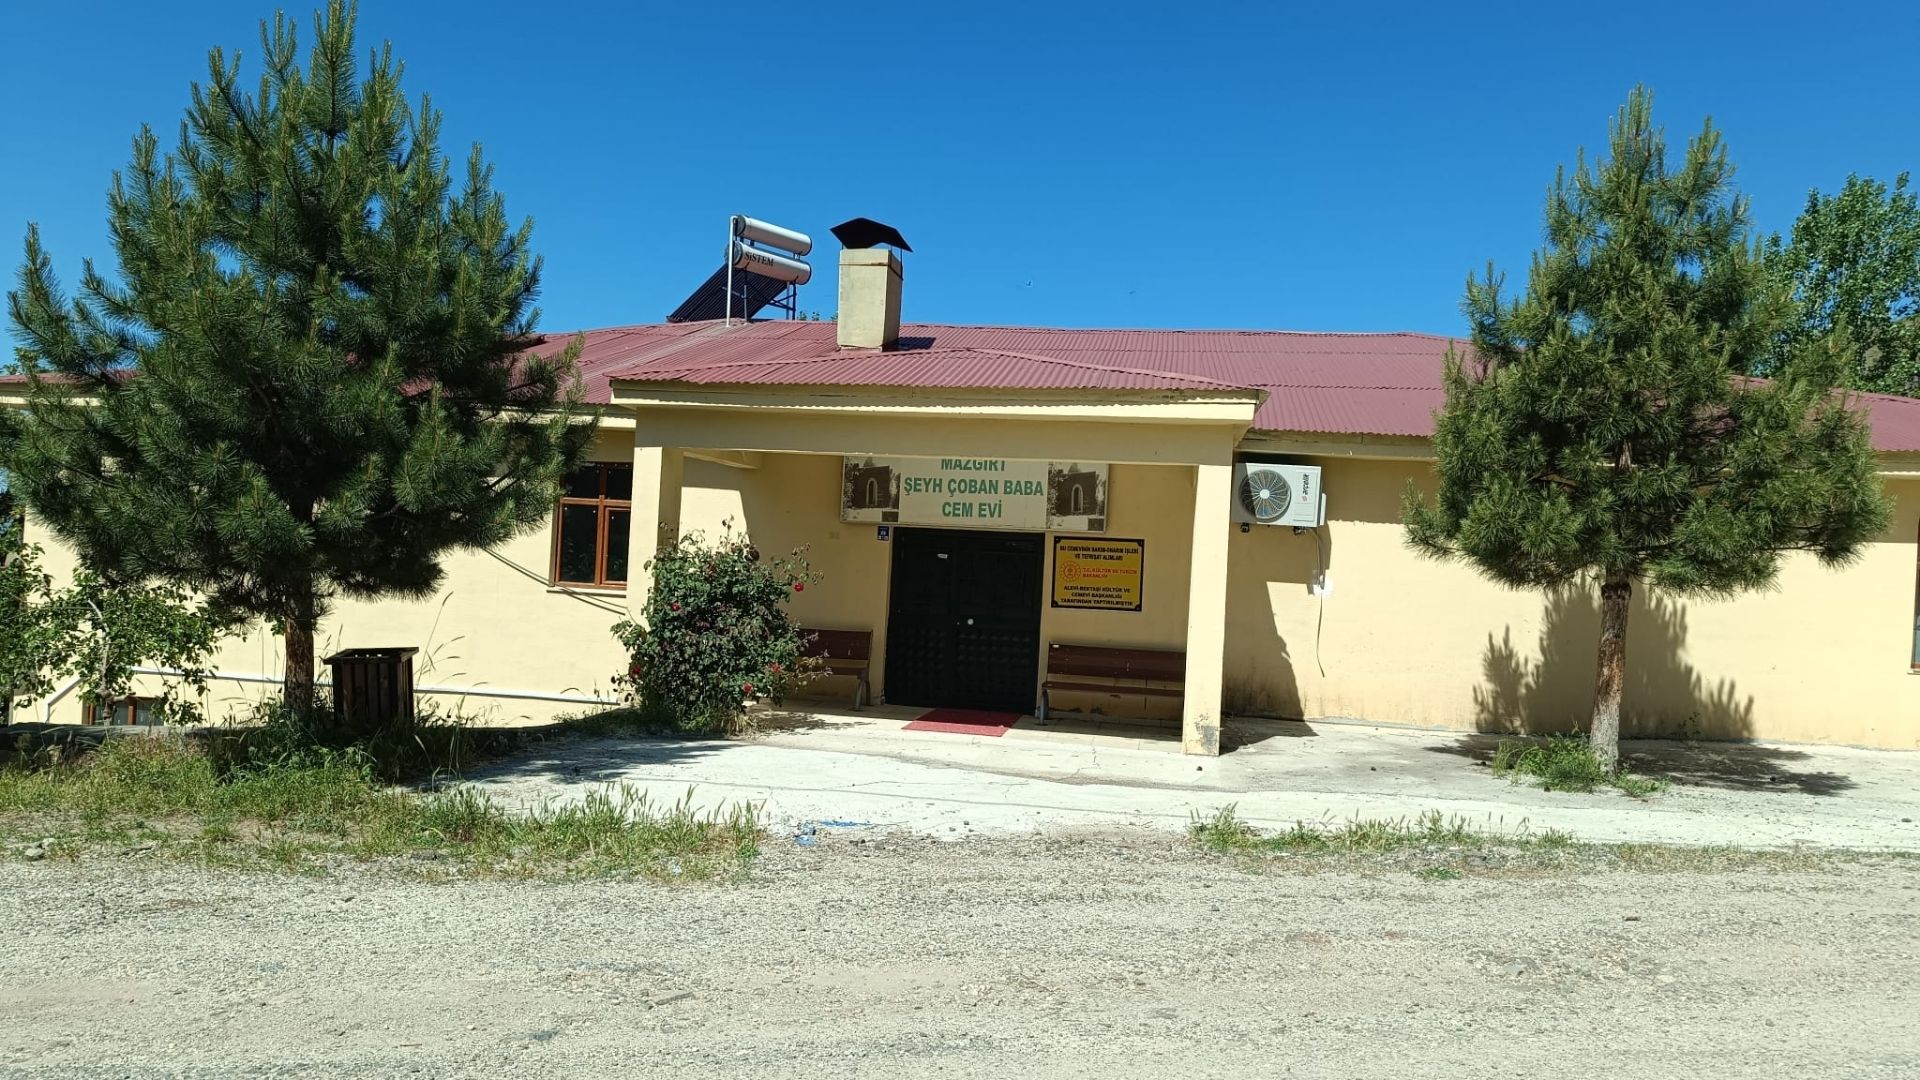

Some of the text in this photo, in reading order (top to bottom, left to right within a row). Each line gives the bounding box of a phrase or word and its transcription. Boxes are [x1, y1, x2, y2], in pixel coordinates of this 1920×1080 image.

[904, 477, 1044, 498] ŞEYH ÇOBAN BABA
[942, 500, 1002, 518] CEM EVİ
